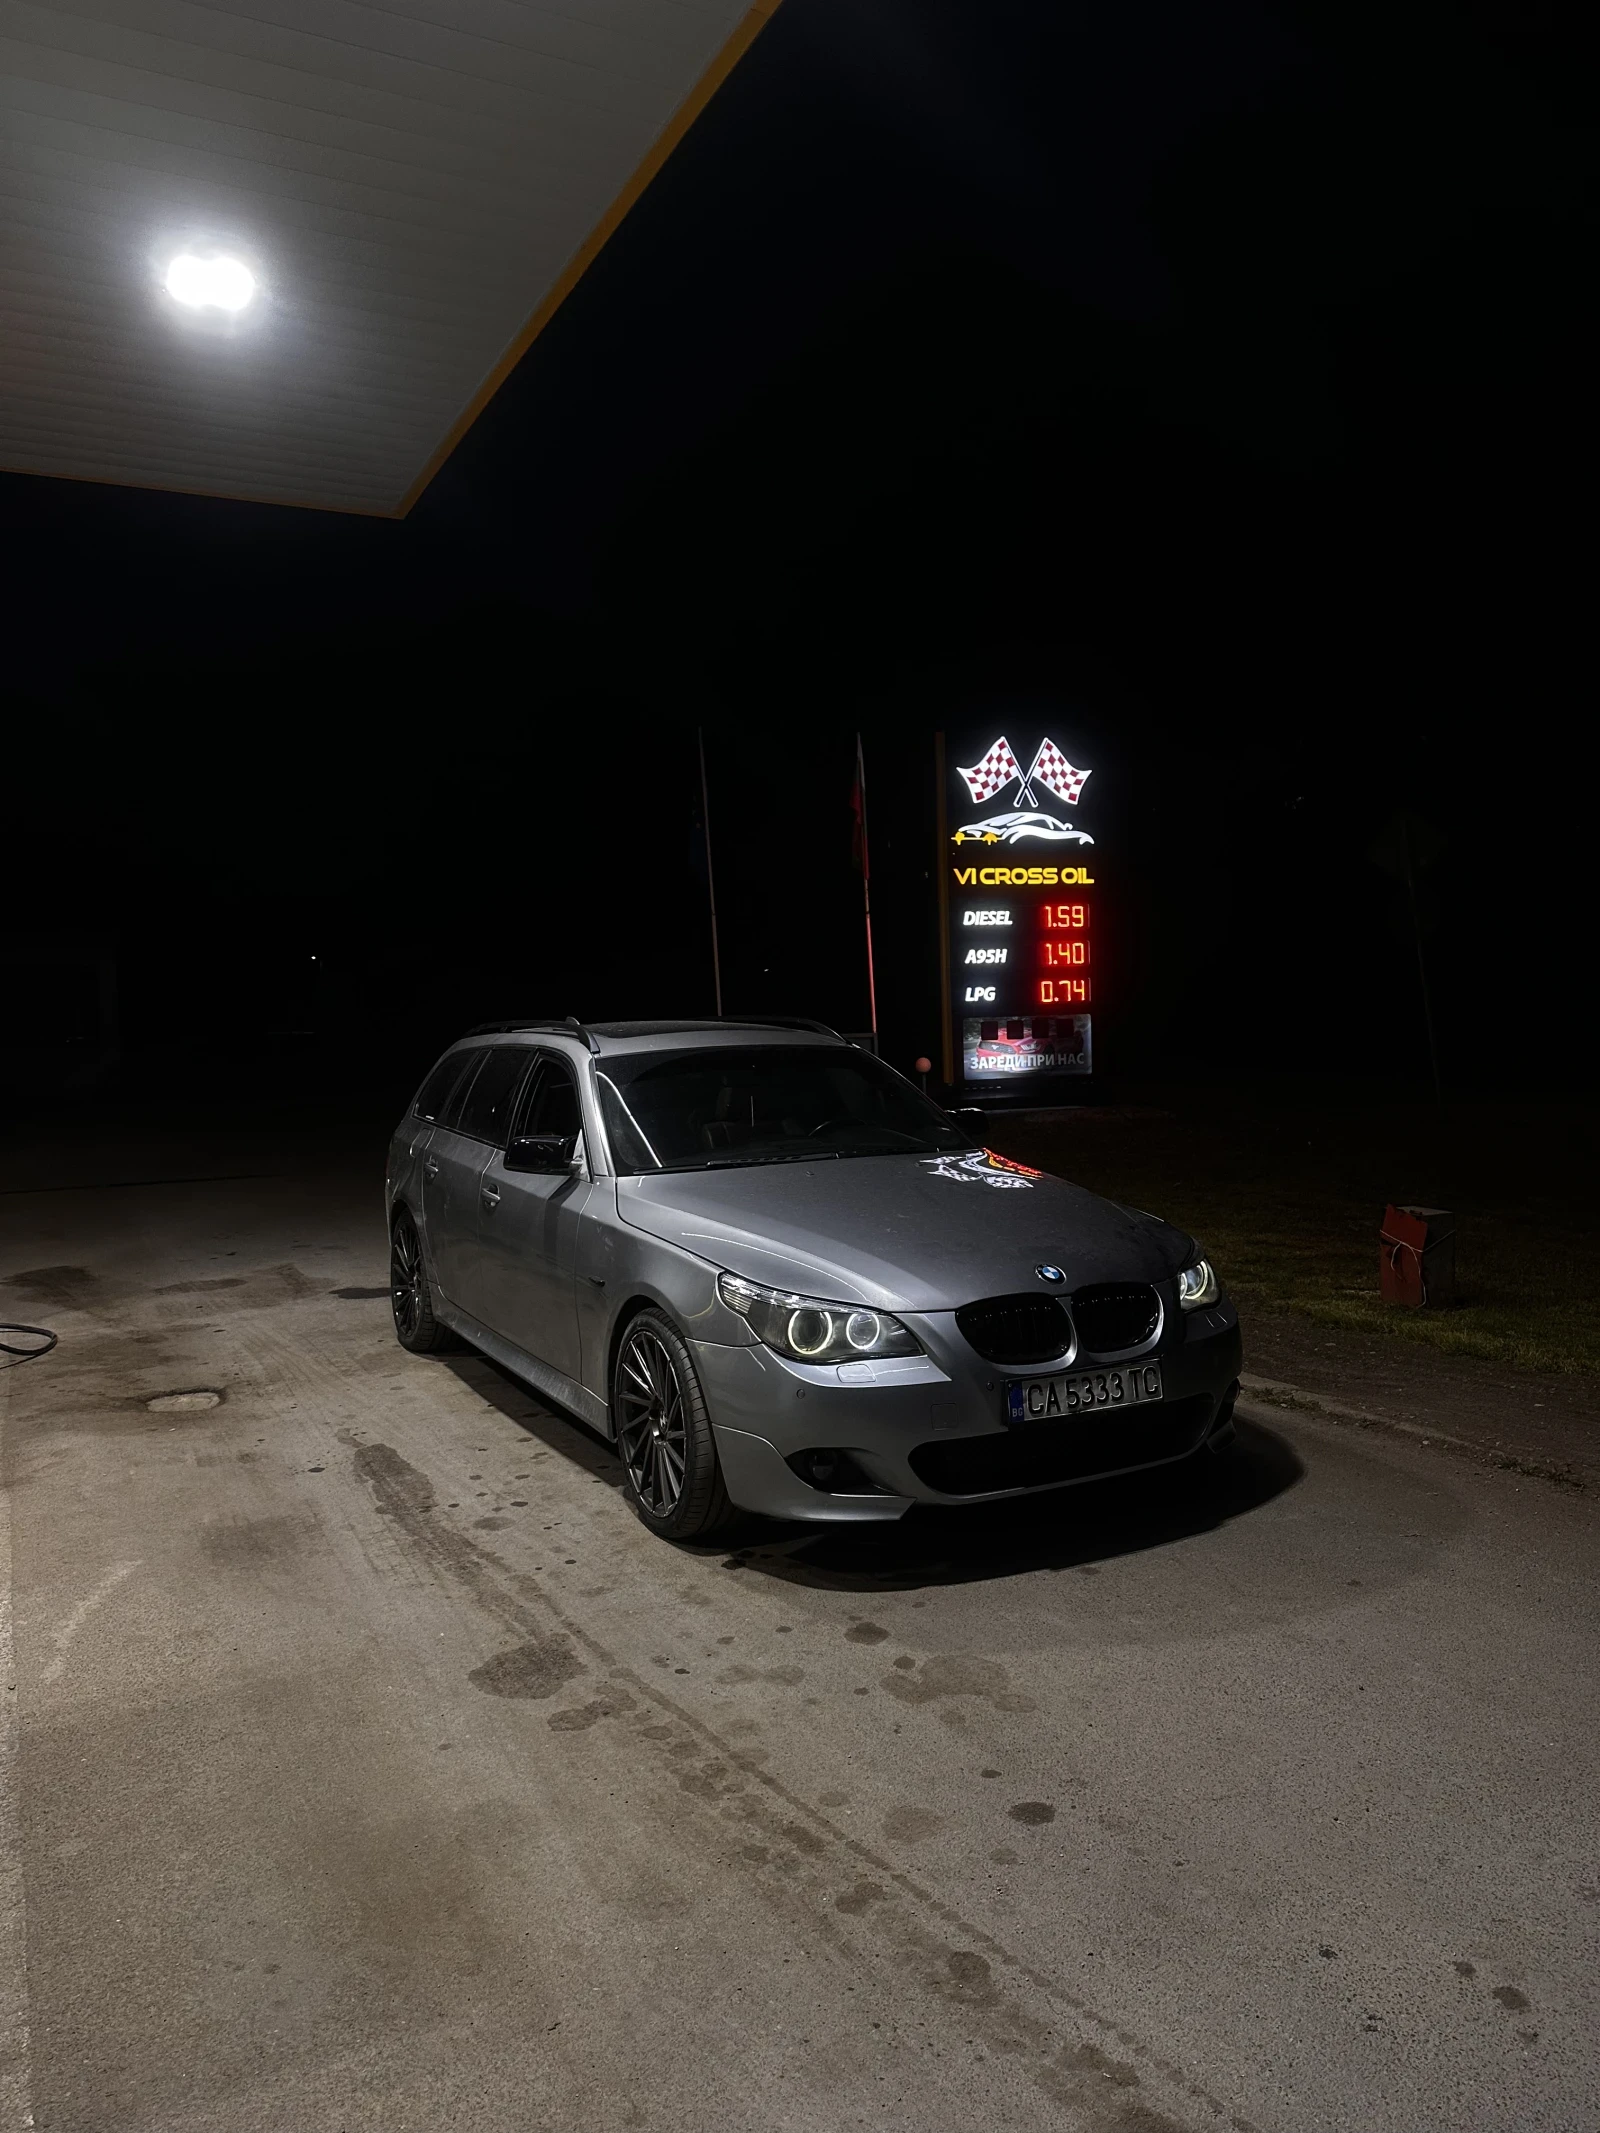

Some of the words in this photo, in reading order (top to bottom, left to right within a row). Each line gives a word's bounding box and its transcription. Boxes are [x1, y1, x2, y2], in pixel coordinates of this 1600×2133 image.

[953, 867, 977, 885] VI
[980, 867, 1059, 885] CROSS
[1060, 867, 1095, 884] OIL
[963, 911, 1013, 926] DIESEL
[1044, 905, 1084, 928] 1.59
[965, 949, 1007, 964] A95H
[1044, 942, 1085, 965] 1.40
[965, 987, 996, 1002] LPG
[1040, 980, 1085, 1003] 0.74
[970, 1055, 1025, 1071] ЗАРЕДИ
[1027, 1055, 1055, 1067] ПРИ
[1057, 1053, 1085, 1066] НАС
[1026, 1382, 1061, 1415] CA
[1065, 1372, 1124, 1408] 5333
[1128, 1365, 1158, 1399] TC
[1012, 1407, 1023, 1417] BG
